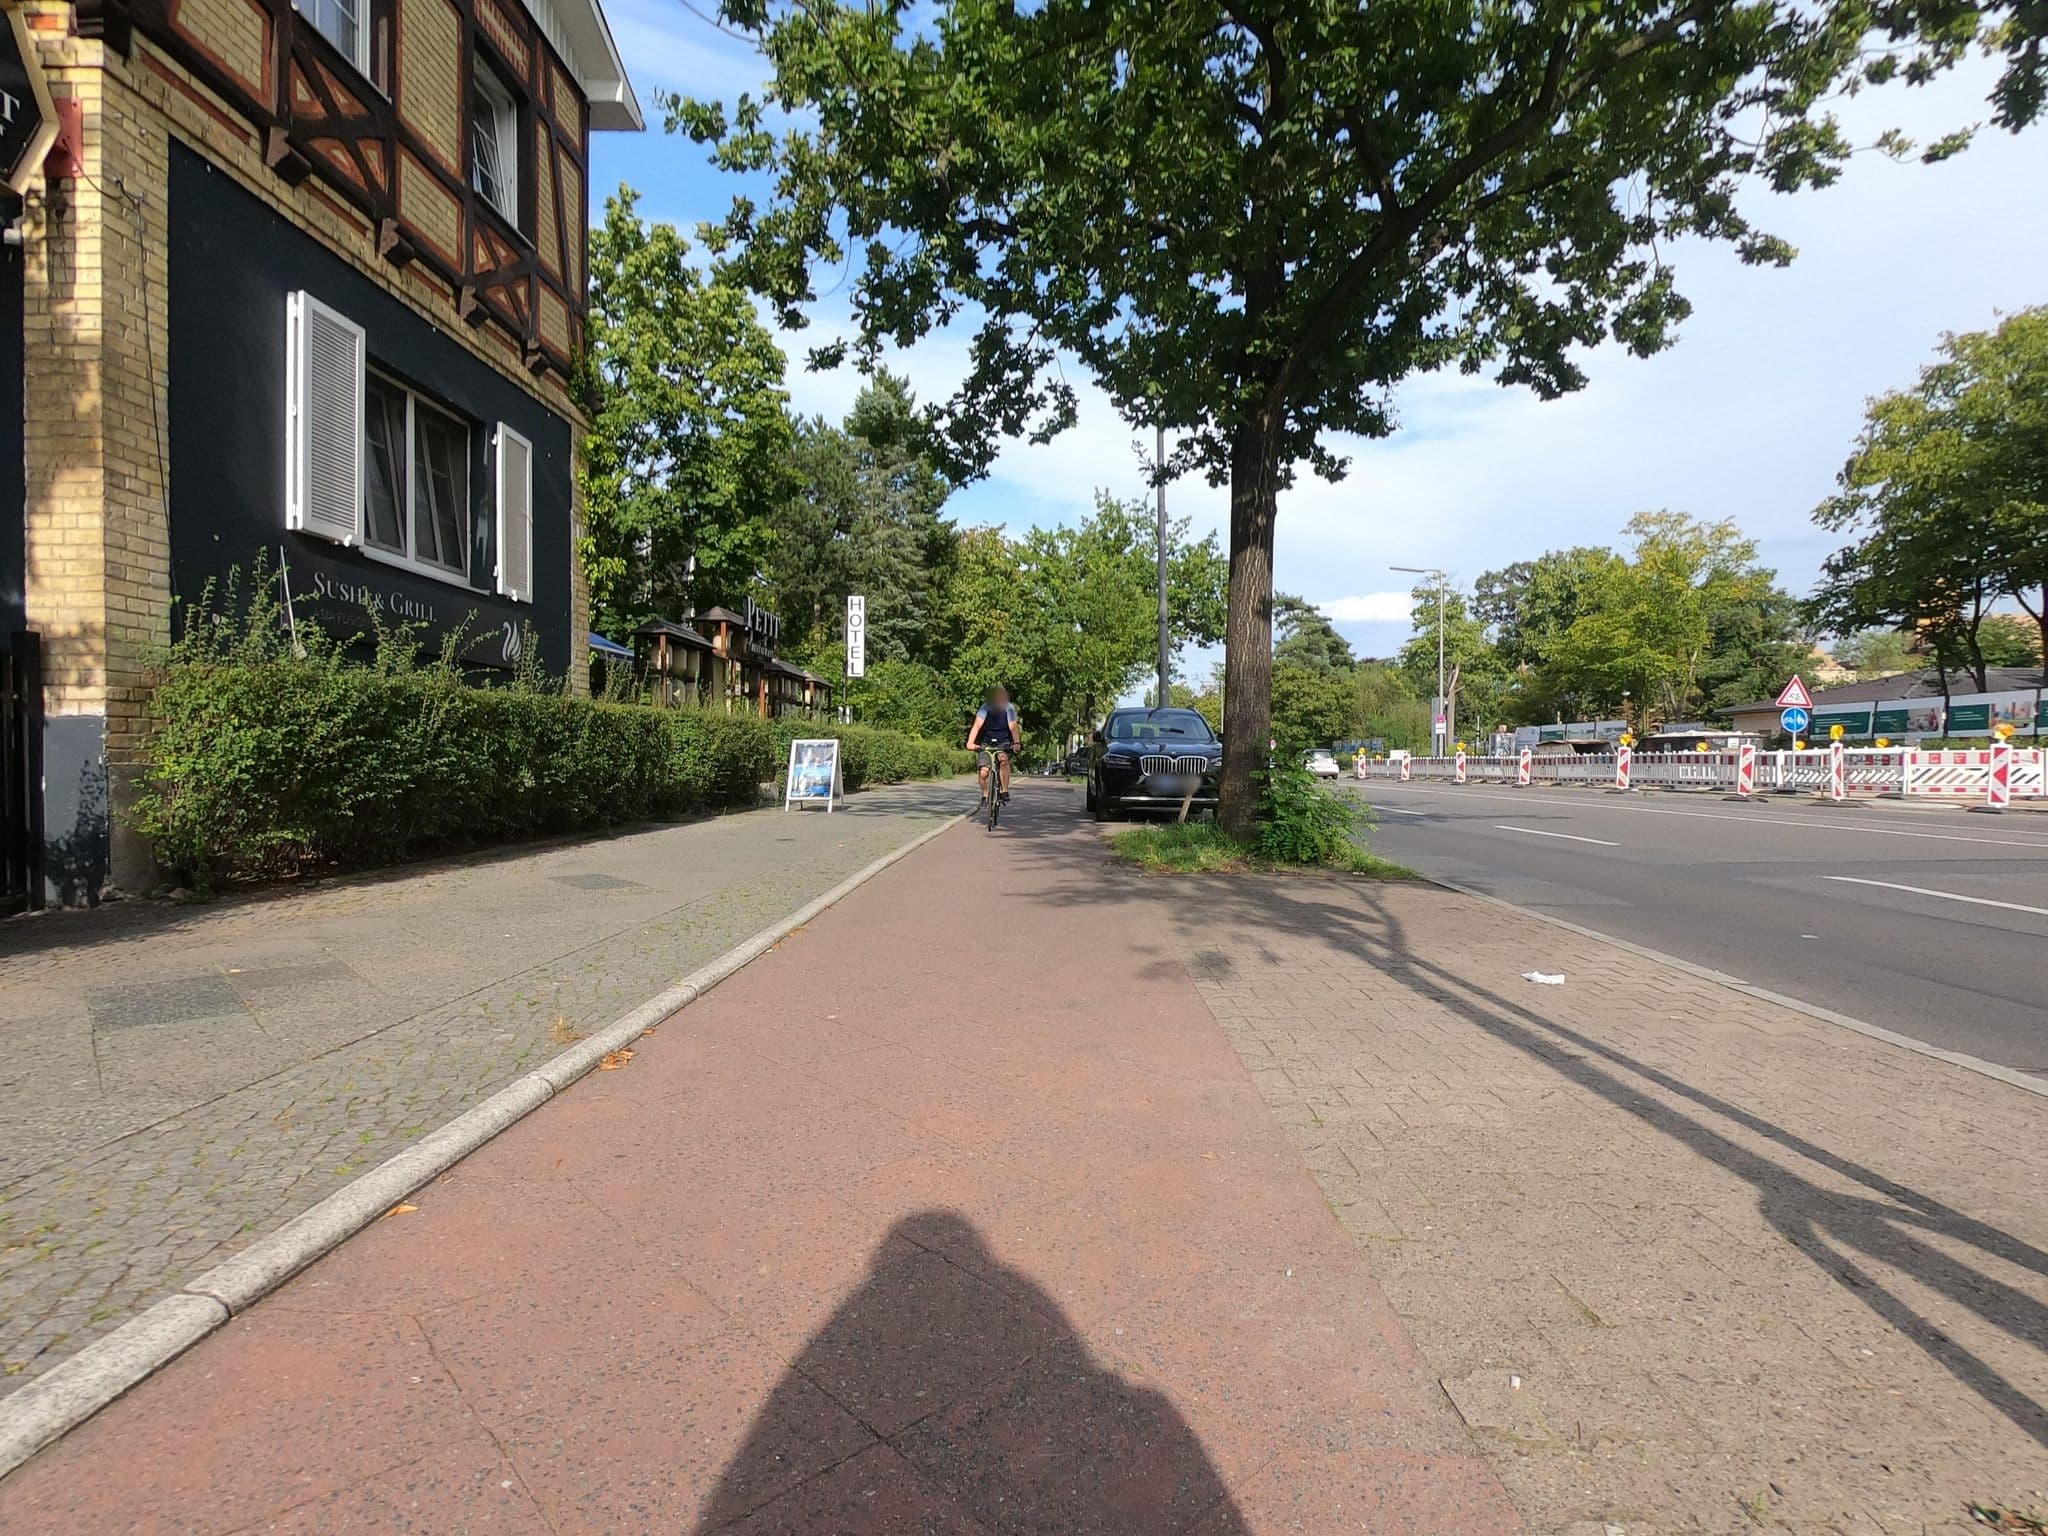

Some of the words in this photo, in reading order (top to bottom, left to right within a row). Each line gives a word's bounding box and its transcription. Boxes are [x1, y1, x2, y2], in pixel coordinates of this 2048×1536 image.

[374, 593, 385, 611] &
[390, 592, 437, 622] GRILL
[850, 598, 862, 675] HOTEL
